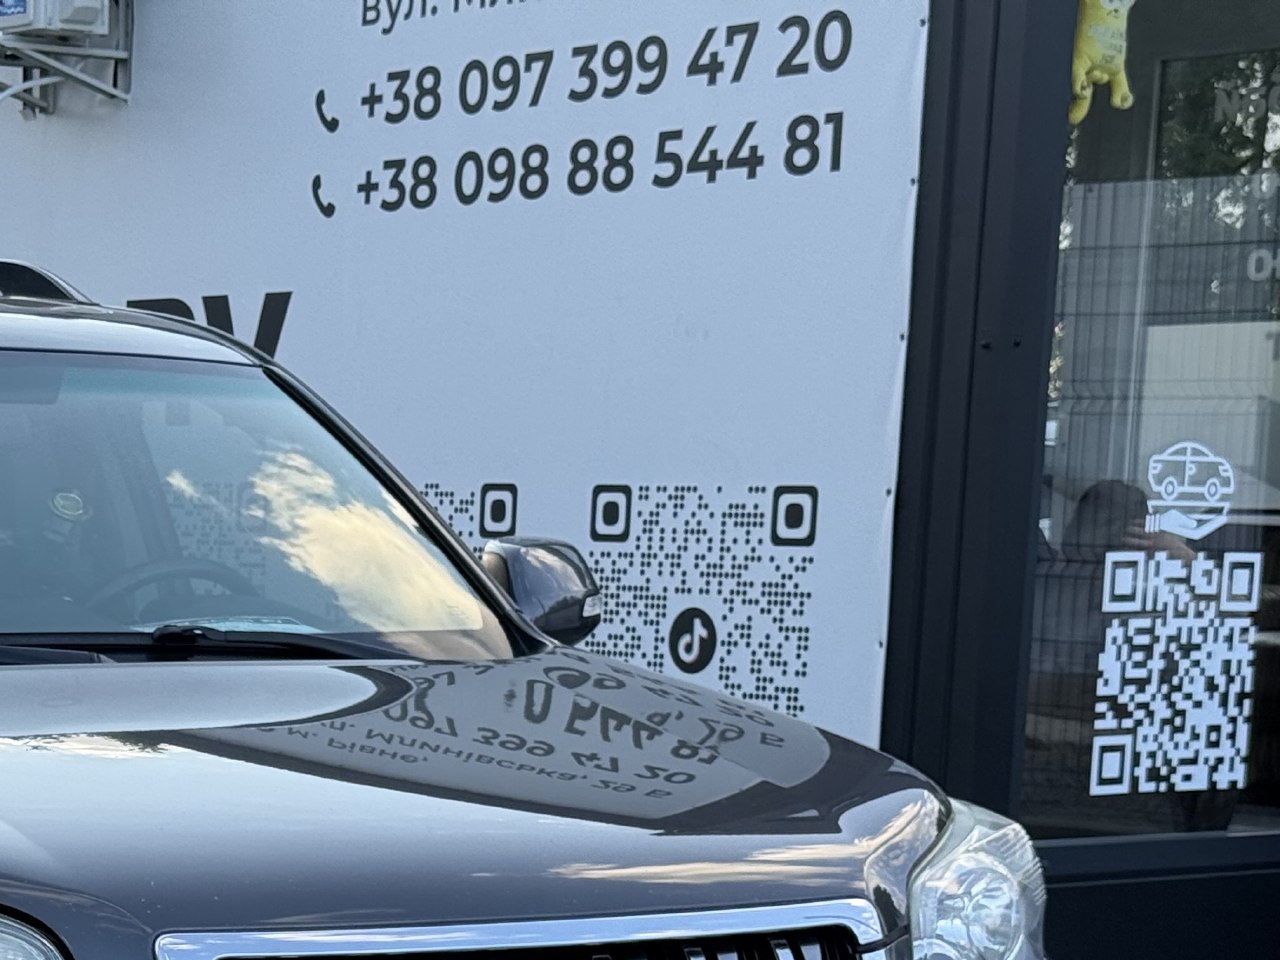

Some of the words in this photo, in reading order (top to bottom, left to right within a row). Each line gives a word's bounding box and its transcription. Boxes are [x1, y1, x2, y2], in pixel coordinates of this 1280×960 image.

[361, 66, 441, 124] +38
[459, 50, 554, 115] 097
[567, 35, 668, 102] 399
[686, 21, 759, 87] 47
[775, 10, 853, 78] 20
[357, 155, 438, 212] +38
[454, 143, 549, 205] 098
[567, 135, 634, 196] 88
[652, 120, 765, 189] 544
[783, 112, 844, 176] 81
